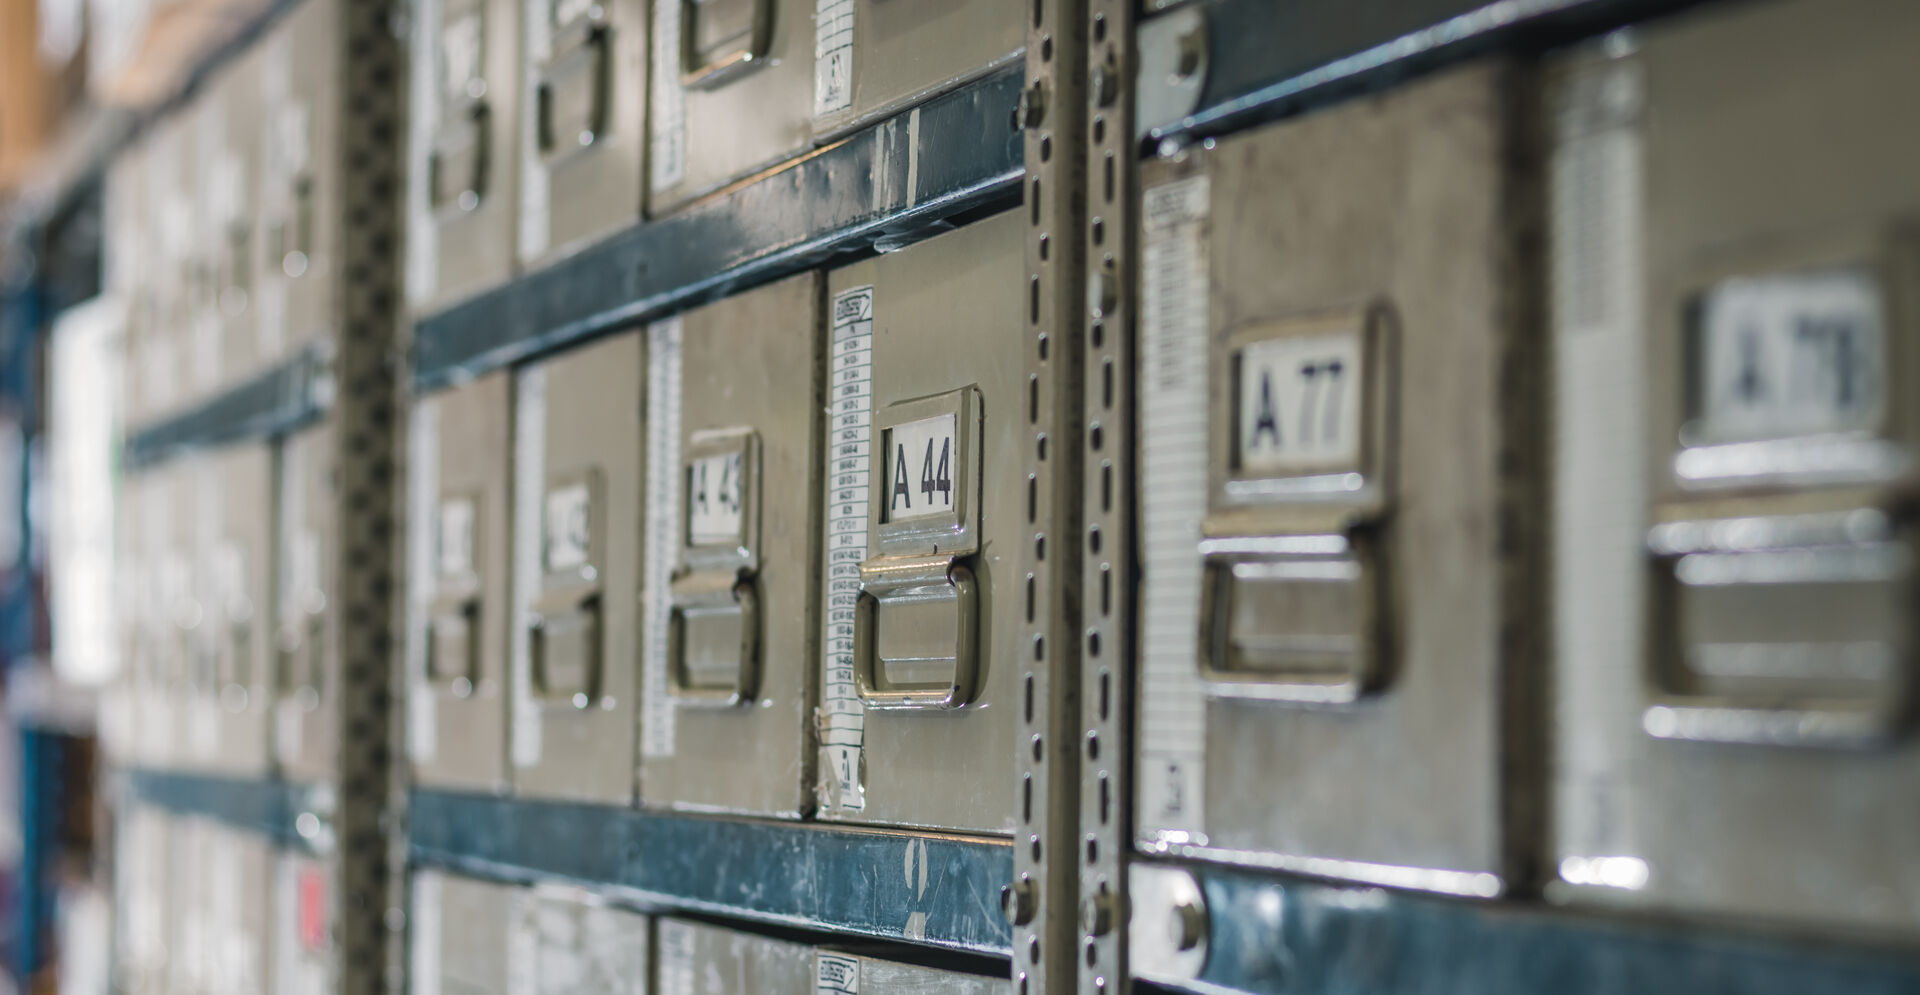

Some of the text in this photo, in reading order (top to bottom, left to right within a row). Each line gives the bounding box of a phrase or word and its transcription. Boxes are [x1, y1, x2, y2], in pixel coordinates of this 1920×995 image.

[1251, 360, 1344, 448] A 77
[692, 461, 709, 516] A
[892, 436, 951, 511] A 44
